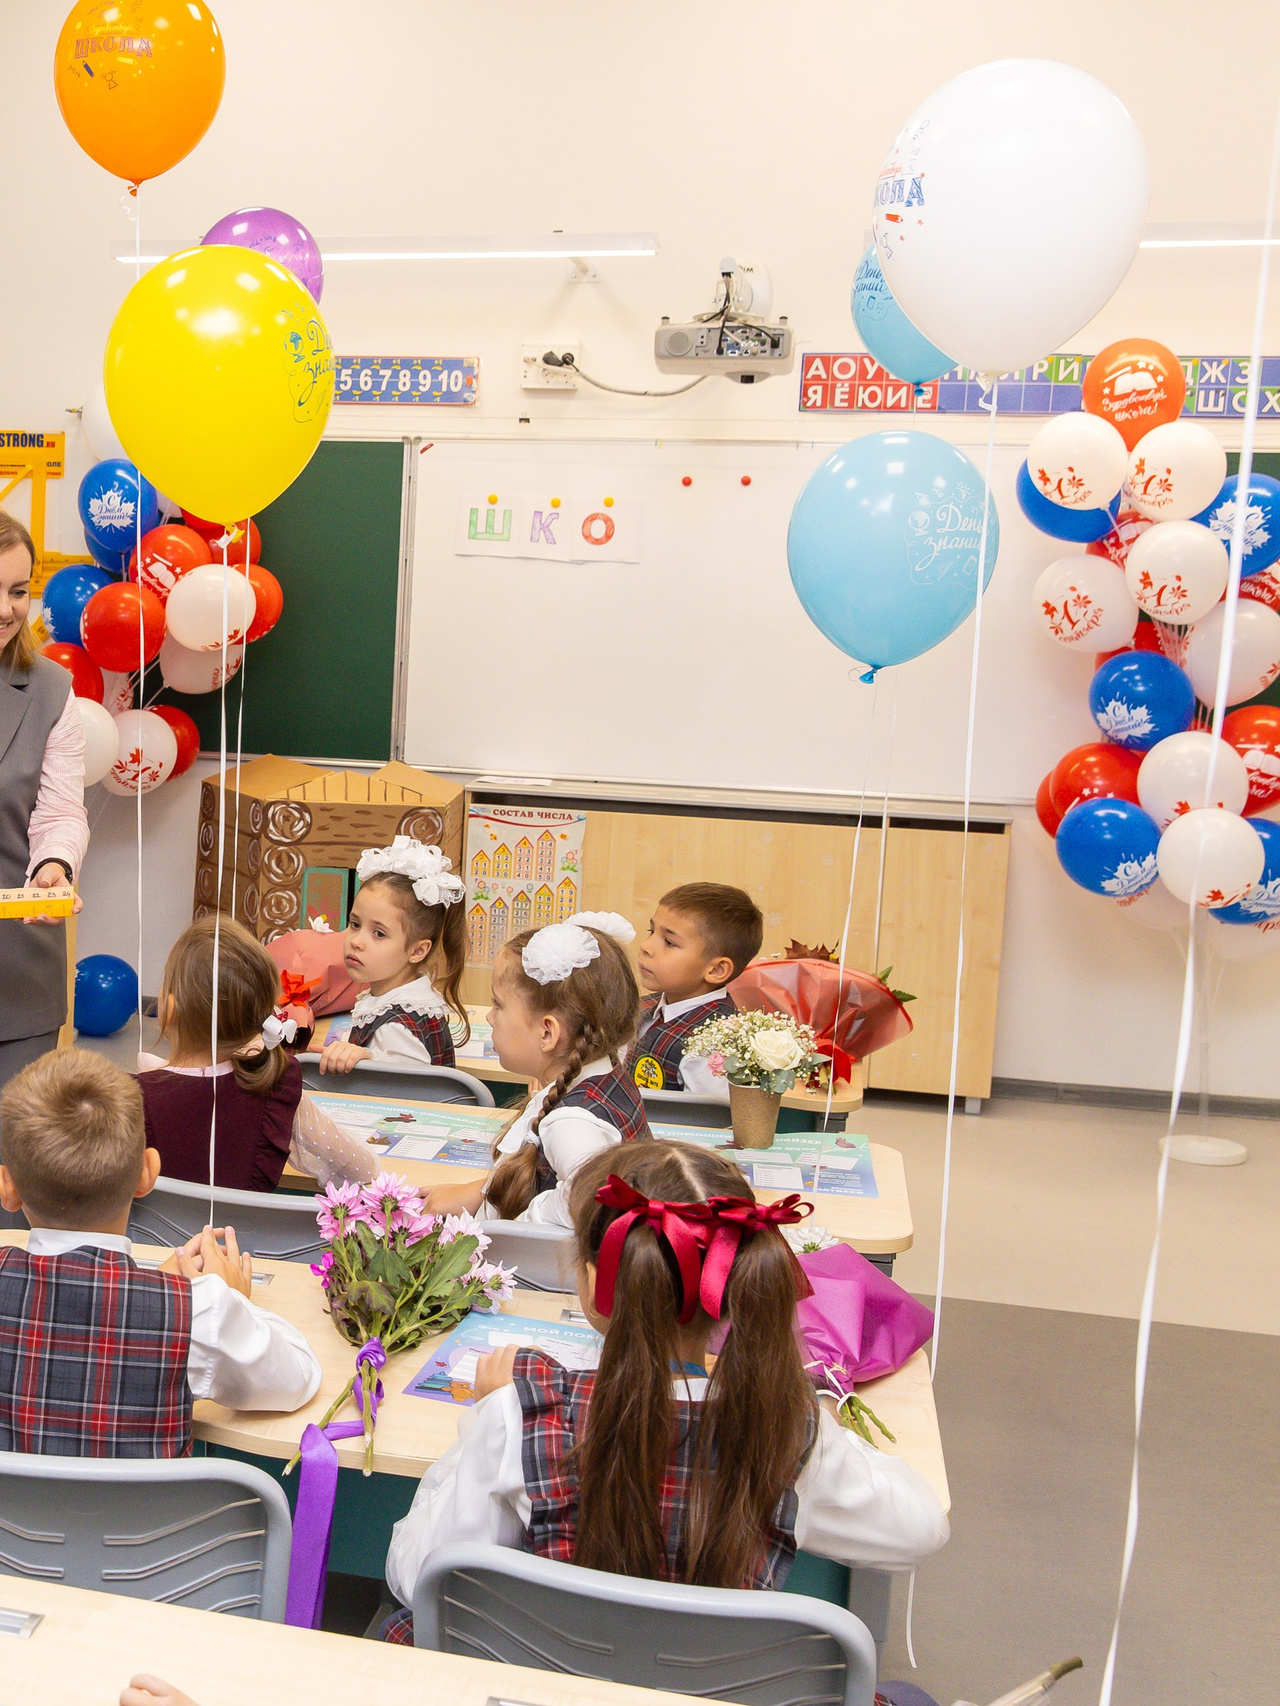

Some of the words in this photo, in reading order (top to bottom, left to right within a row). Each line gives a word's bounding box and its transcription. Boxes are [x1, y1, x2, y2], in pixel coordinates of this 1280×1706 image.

[75, 36, 153, 59] ШКОЛА
[874, 177, 925, 207] КОЛА
[339, 369, 352, 391] 5
[359, 369, 372, 391] 6
[379, 369, 392, 391] 7
[398, 369, 411, 392] 8
[418, 370, 431, 392] 9
[438, 370, 463, 392] 10
[806, 358, 827, 379] А
[832, 357, 856, 380] О
[1058, 357, 1080, 381] Й
[1199, 360, 1227, 384] Ж
[805, 385, 822, 407] Я
[834, 382, 849, 408] Ё
[858, 385, 882, 408] Ю
[886, 386, 907, 408] И
[1198, 389, 1224, 413] Ш
[467, 508, 512, 542] Ш
[530, 510, 560, 545] К
[581, 512, 615, 546] О
[492, 808, 534, 818] СОСТАВ
[537, 811, 573, 821] ЧИСЛА
[523, 1325, 561, 1336] МОЙ
